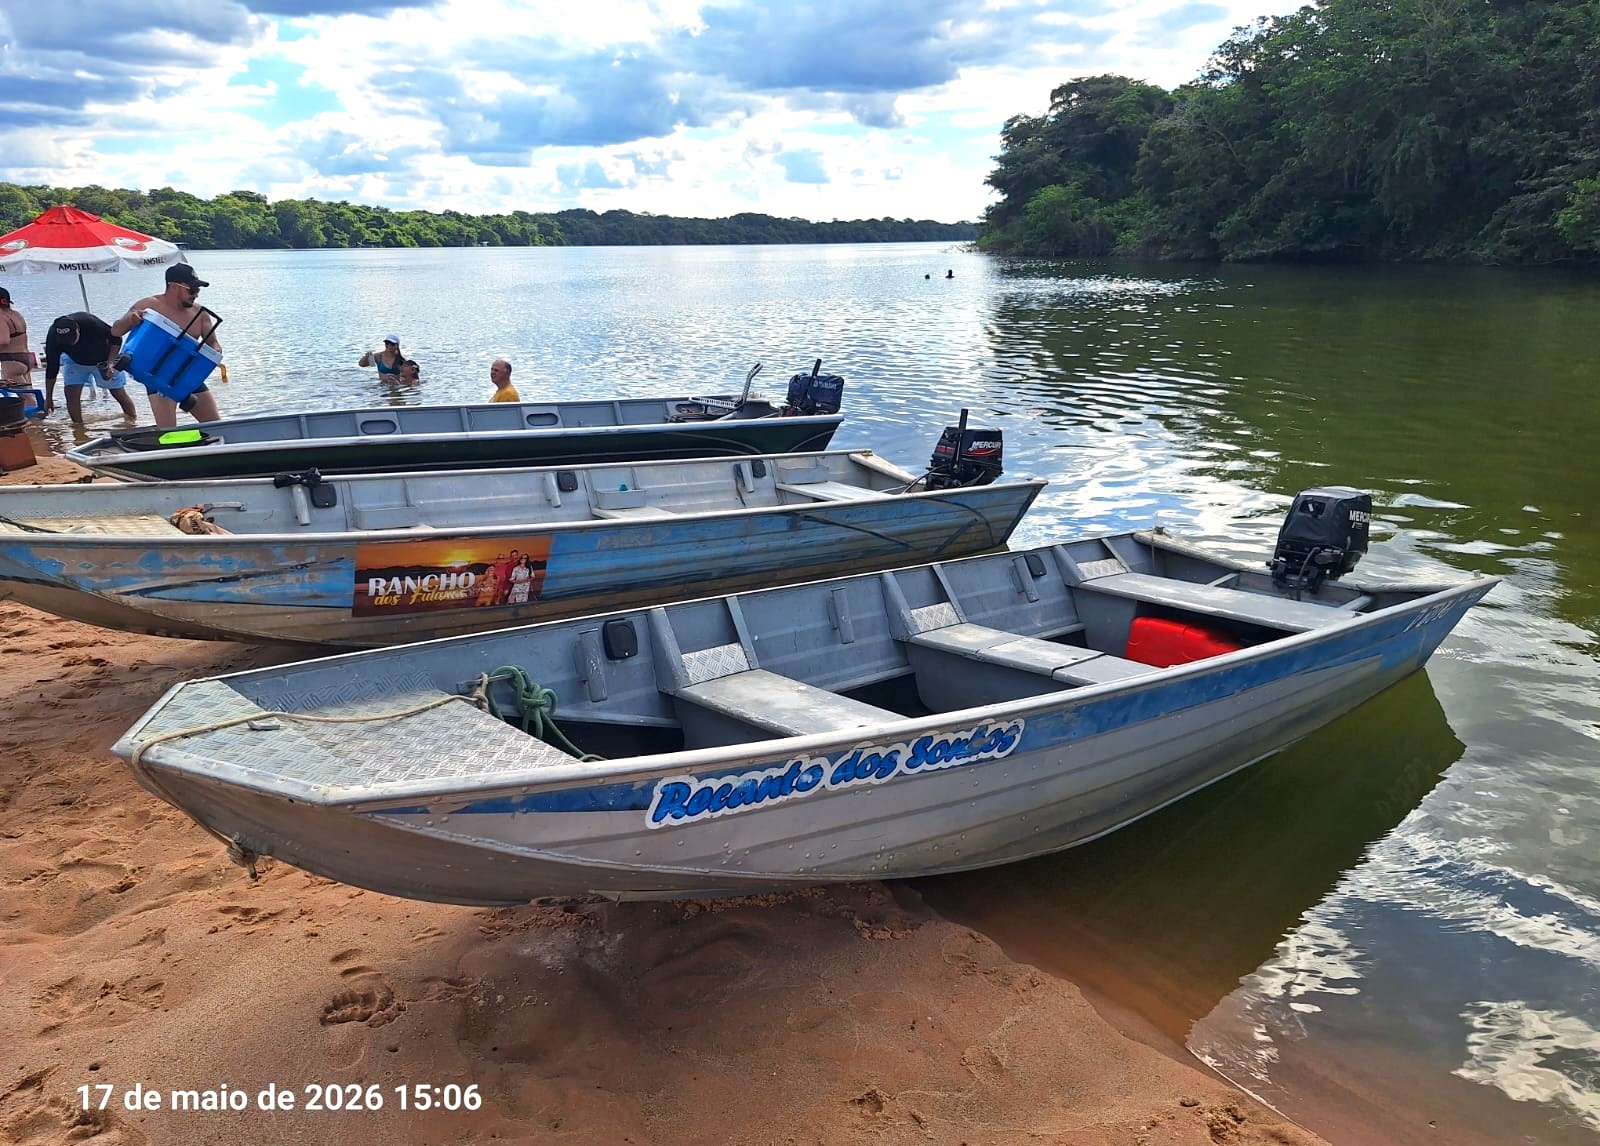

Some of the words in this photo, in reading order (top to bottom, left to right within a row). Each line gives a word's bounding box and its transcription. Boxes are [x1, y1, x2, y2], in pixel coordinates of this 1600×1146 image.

[58, 263, 92, 271] AMSTEL
[368, 571, 476, 596] RANCHO
[374, 592, 401, 606] dos
[650, 759, 824, 823] Recanto
[829, 747, 901, 786] dos
